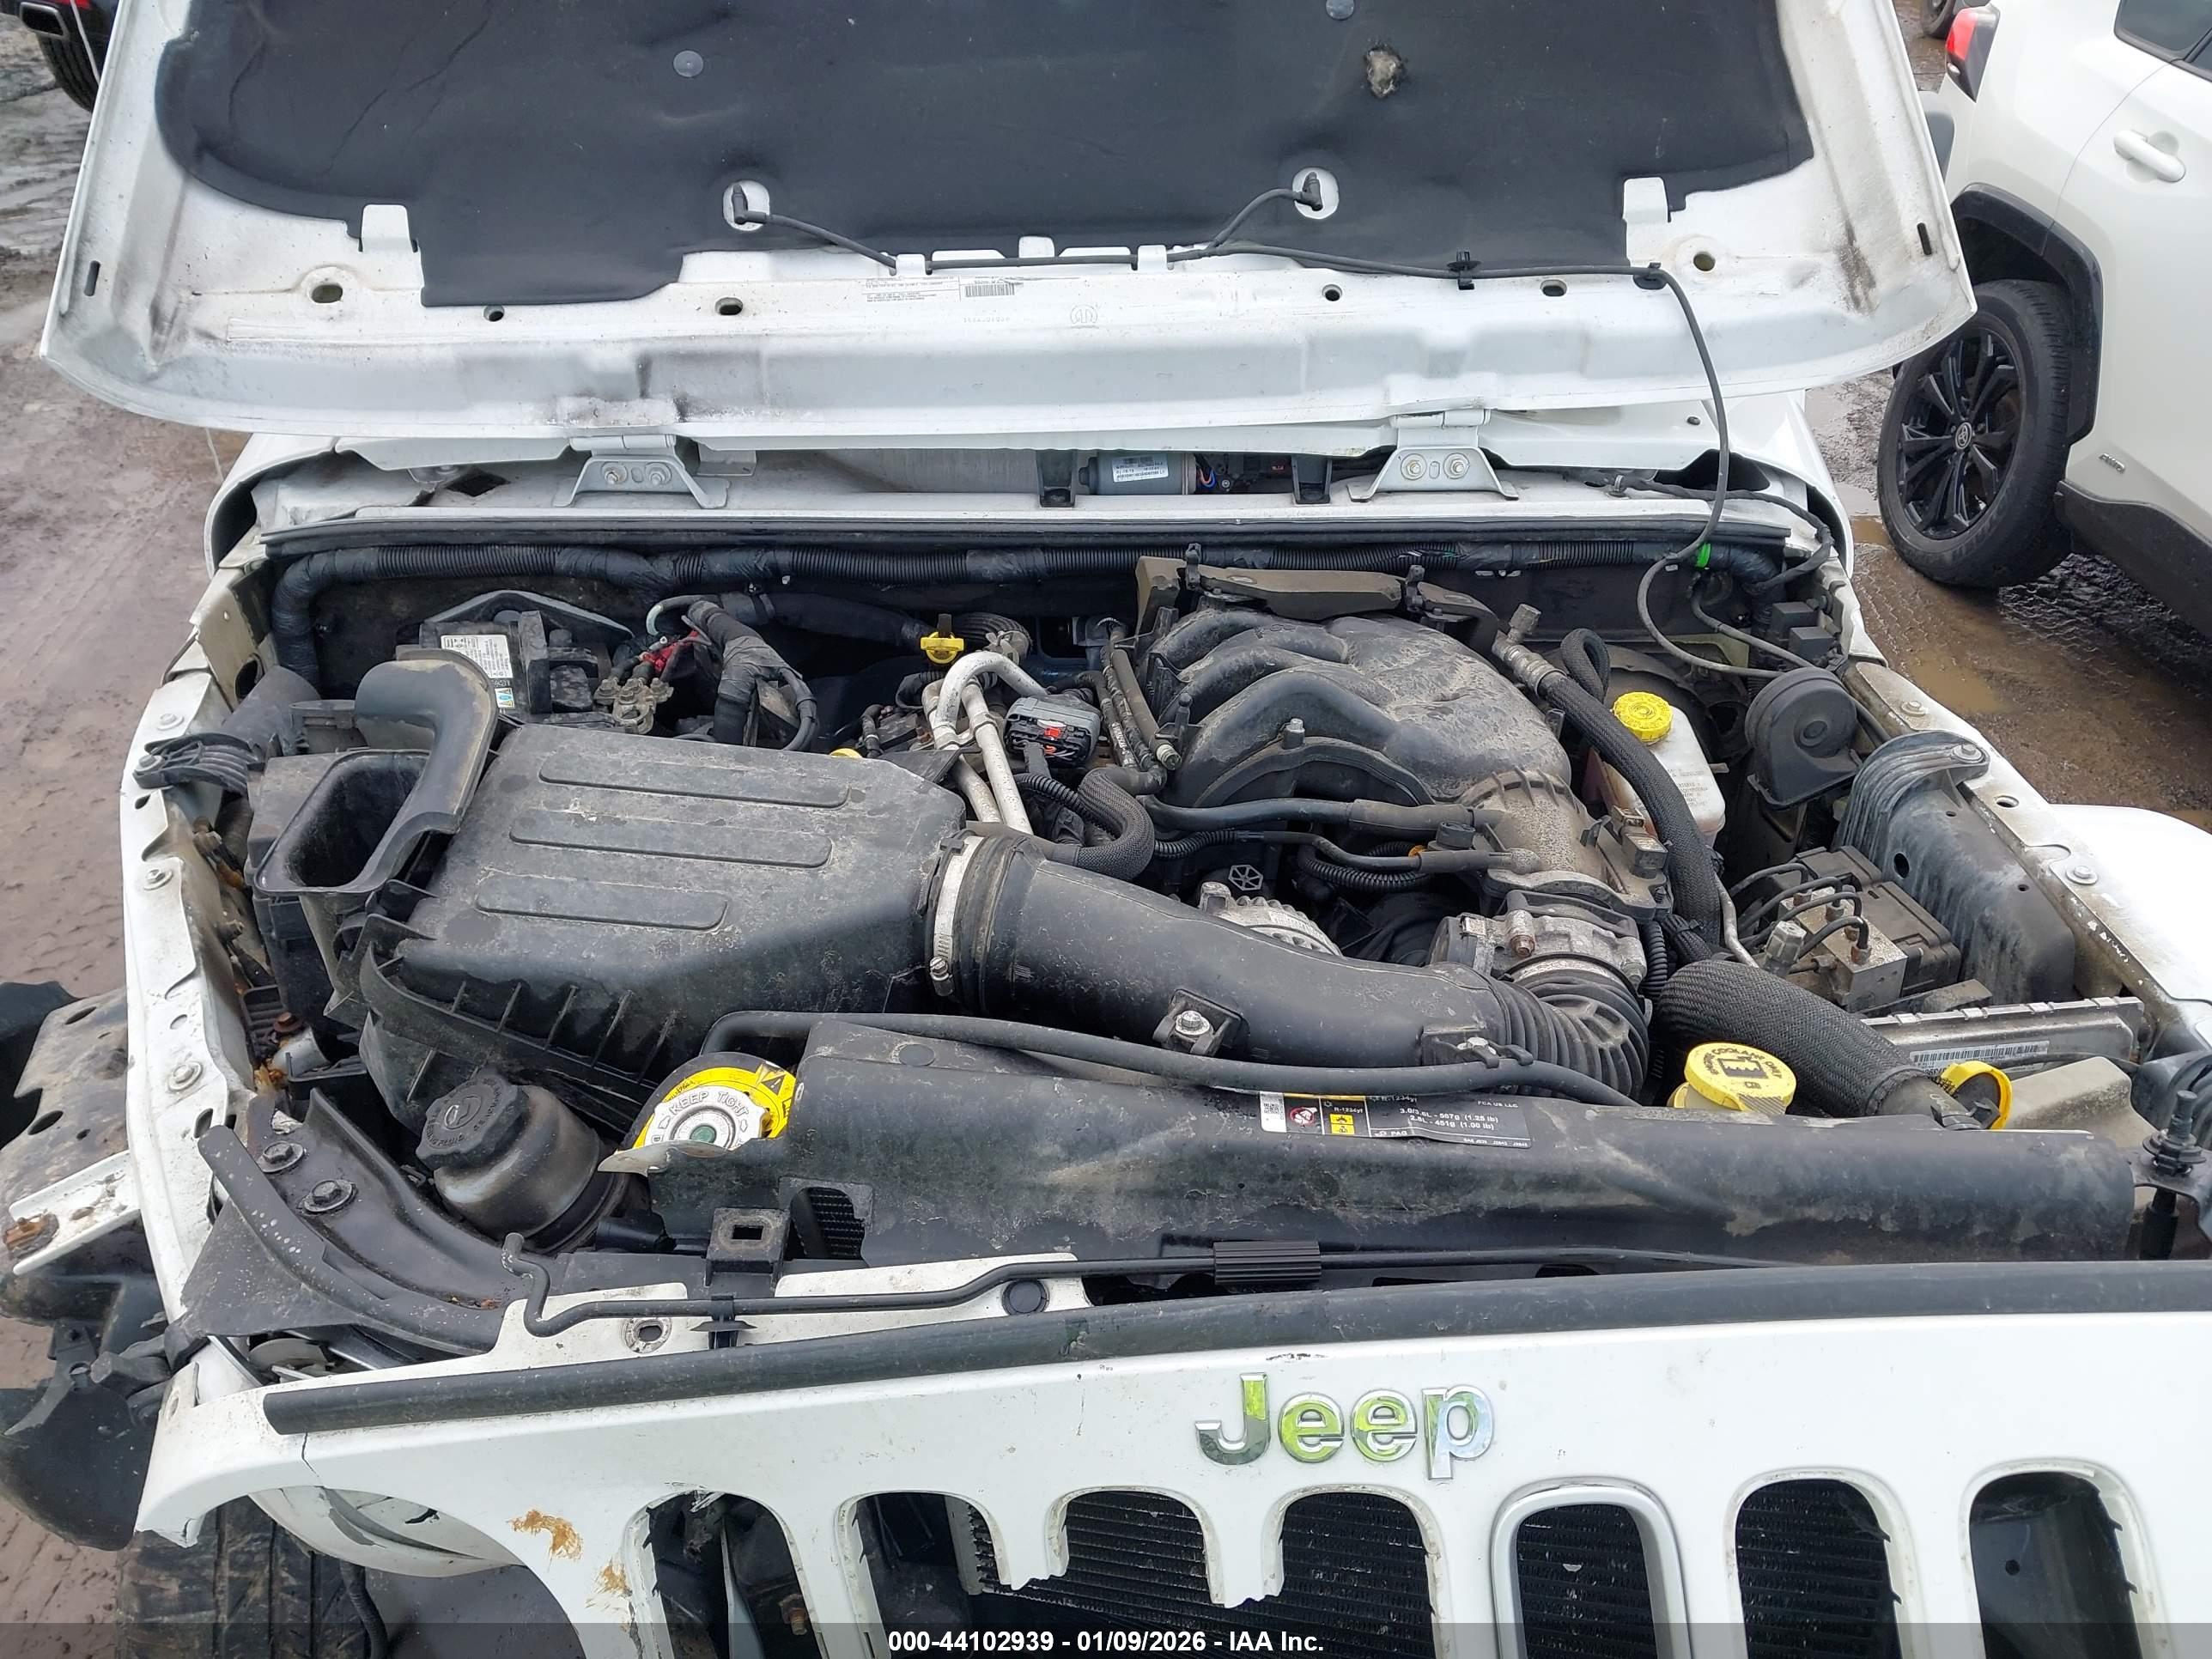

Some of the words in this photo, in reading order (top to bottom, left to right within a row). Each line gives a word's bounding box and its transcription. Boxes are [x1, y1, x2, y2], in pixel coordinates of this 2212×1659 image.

[669, 1091, 709, 1115] KEEP
[716, 1091, 750, 1116] TIGHT
[1399, 1108, 1432, 1118] 3.0/3.6L
[1486, 1115, 1498, 1124] lb)
[1434, 1120, 1456, 1128] 451g
[1460, 1121, 1481, 1129] (1.00
[1194, 1371, 1494, 1480] Jeep
